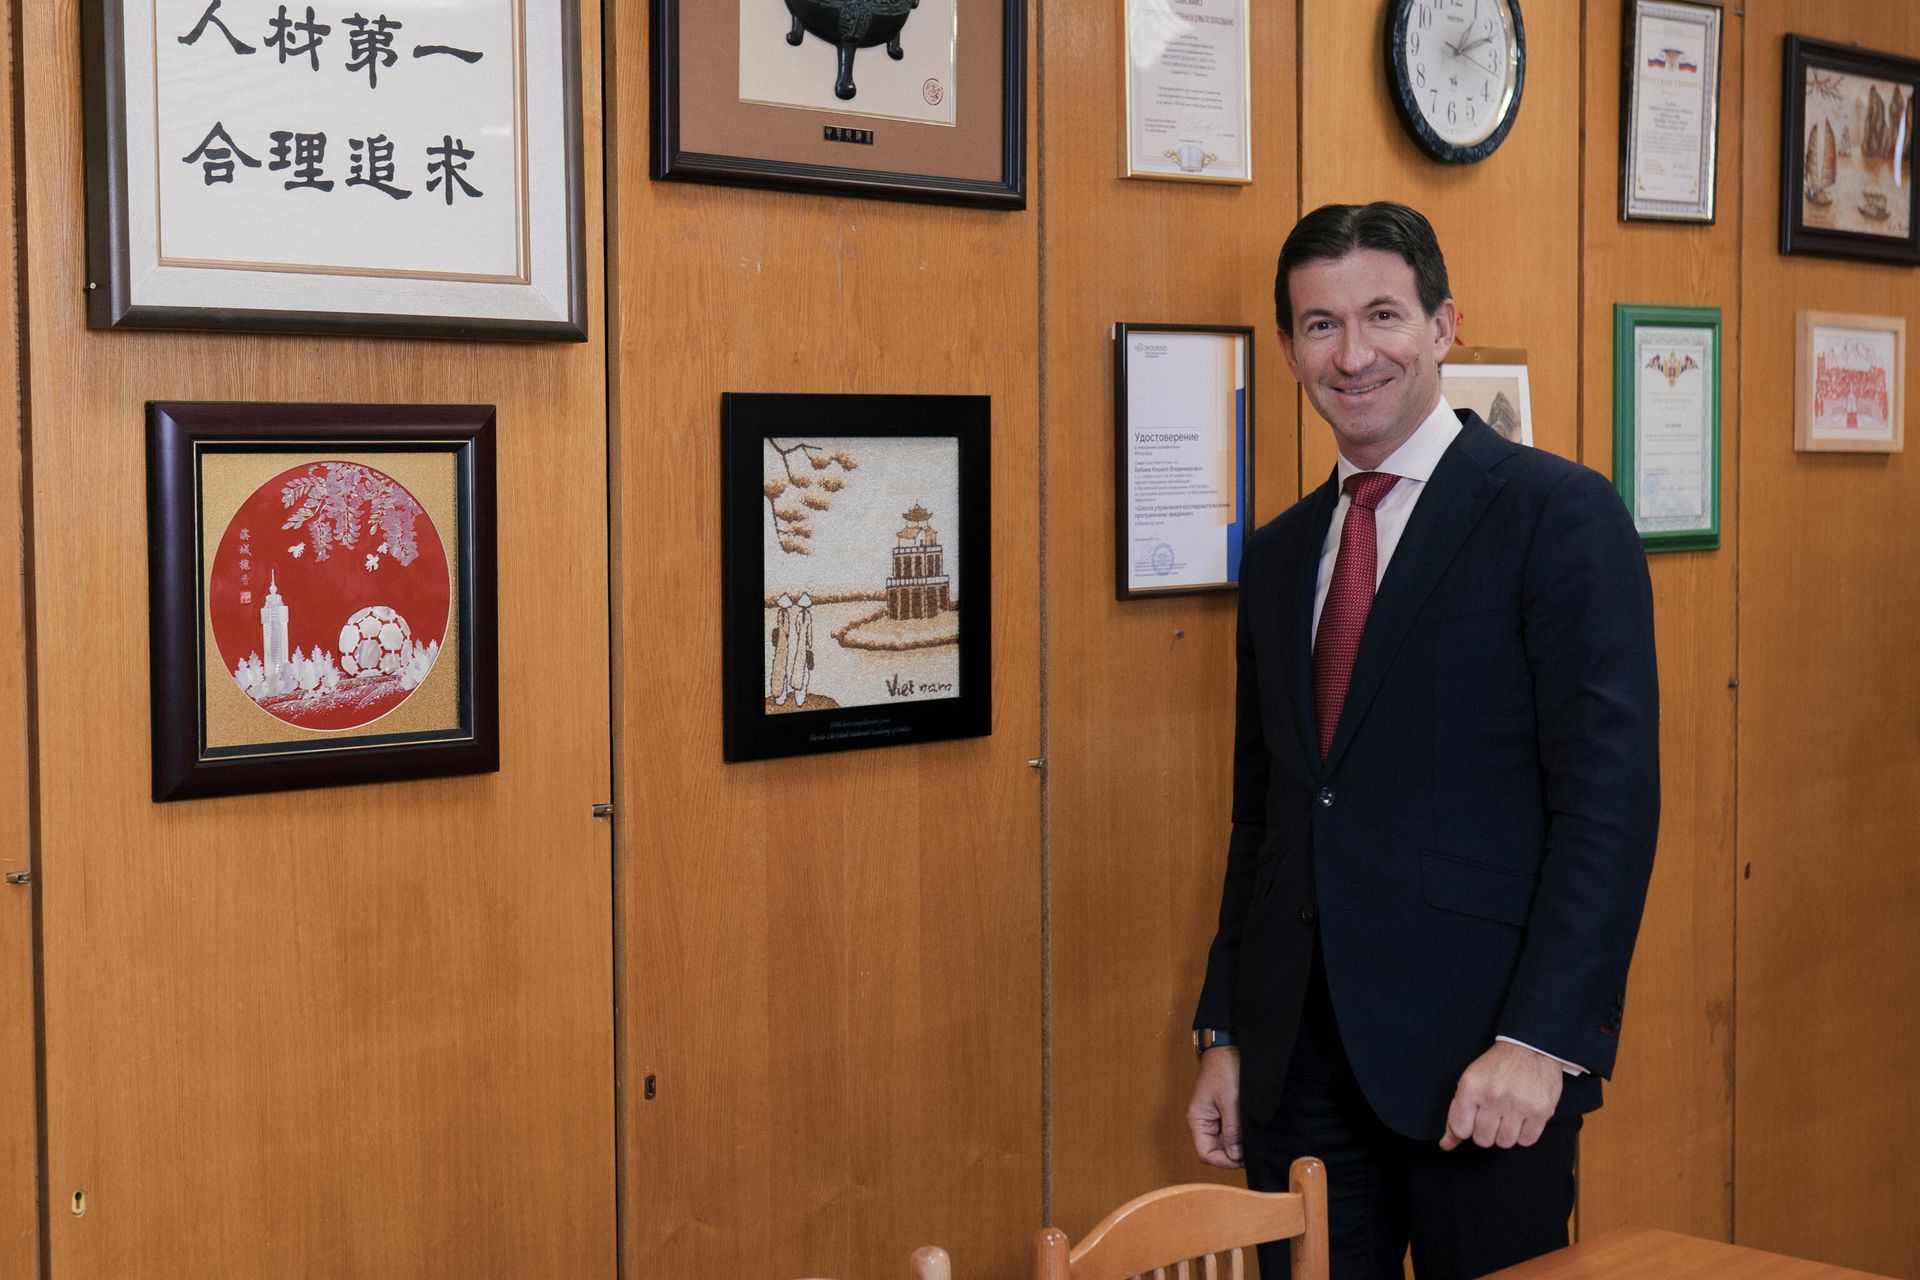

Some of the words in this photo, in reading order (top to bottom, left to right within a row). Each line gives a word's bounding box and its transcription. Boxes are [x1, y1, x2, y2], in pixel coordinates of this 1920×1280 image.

[1418, 3, 1432, 31] 10
[1411, 31, 1420, 57] 9
[1488, 49, 1498, 76] 3
[1416, 63, 1426, 89] 8
[1430, 88, 1438, 114] 7
[1480, 78, 1490, 102] 4
[1447, 101, 1456, 126] 6
[1466, 96, 1475, 121] 5
[182, 121, 484, 206] 合理追求
[1134, 432, 1199, 443] Удостоверение
[886, 673, 914, 697] Viet
[919, 683, 952, 693] nam
